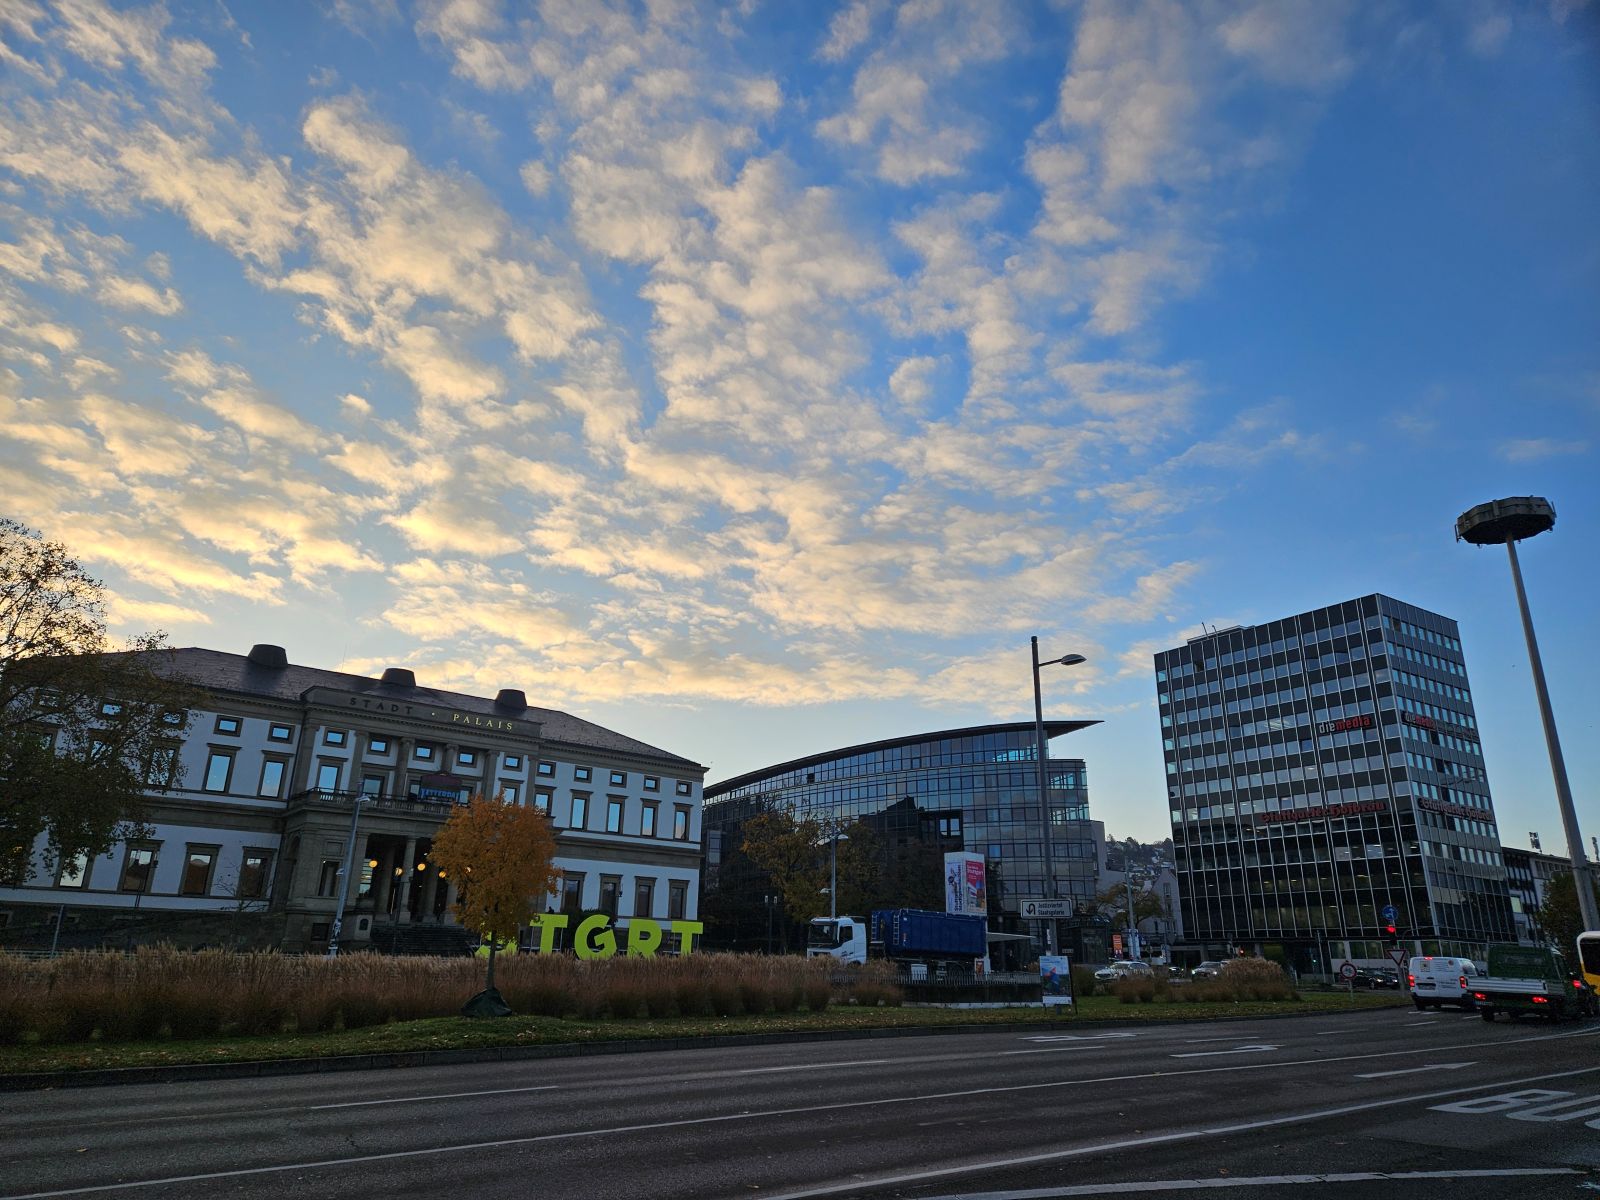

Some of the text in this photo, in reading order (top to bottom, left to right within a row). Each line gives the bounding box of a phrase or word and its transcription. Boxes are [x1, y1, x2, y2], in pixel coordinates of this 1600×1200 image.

[350, 698, 513, 731] STADT PALAIS
[1425, 1088, 1600, 1130] BU
